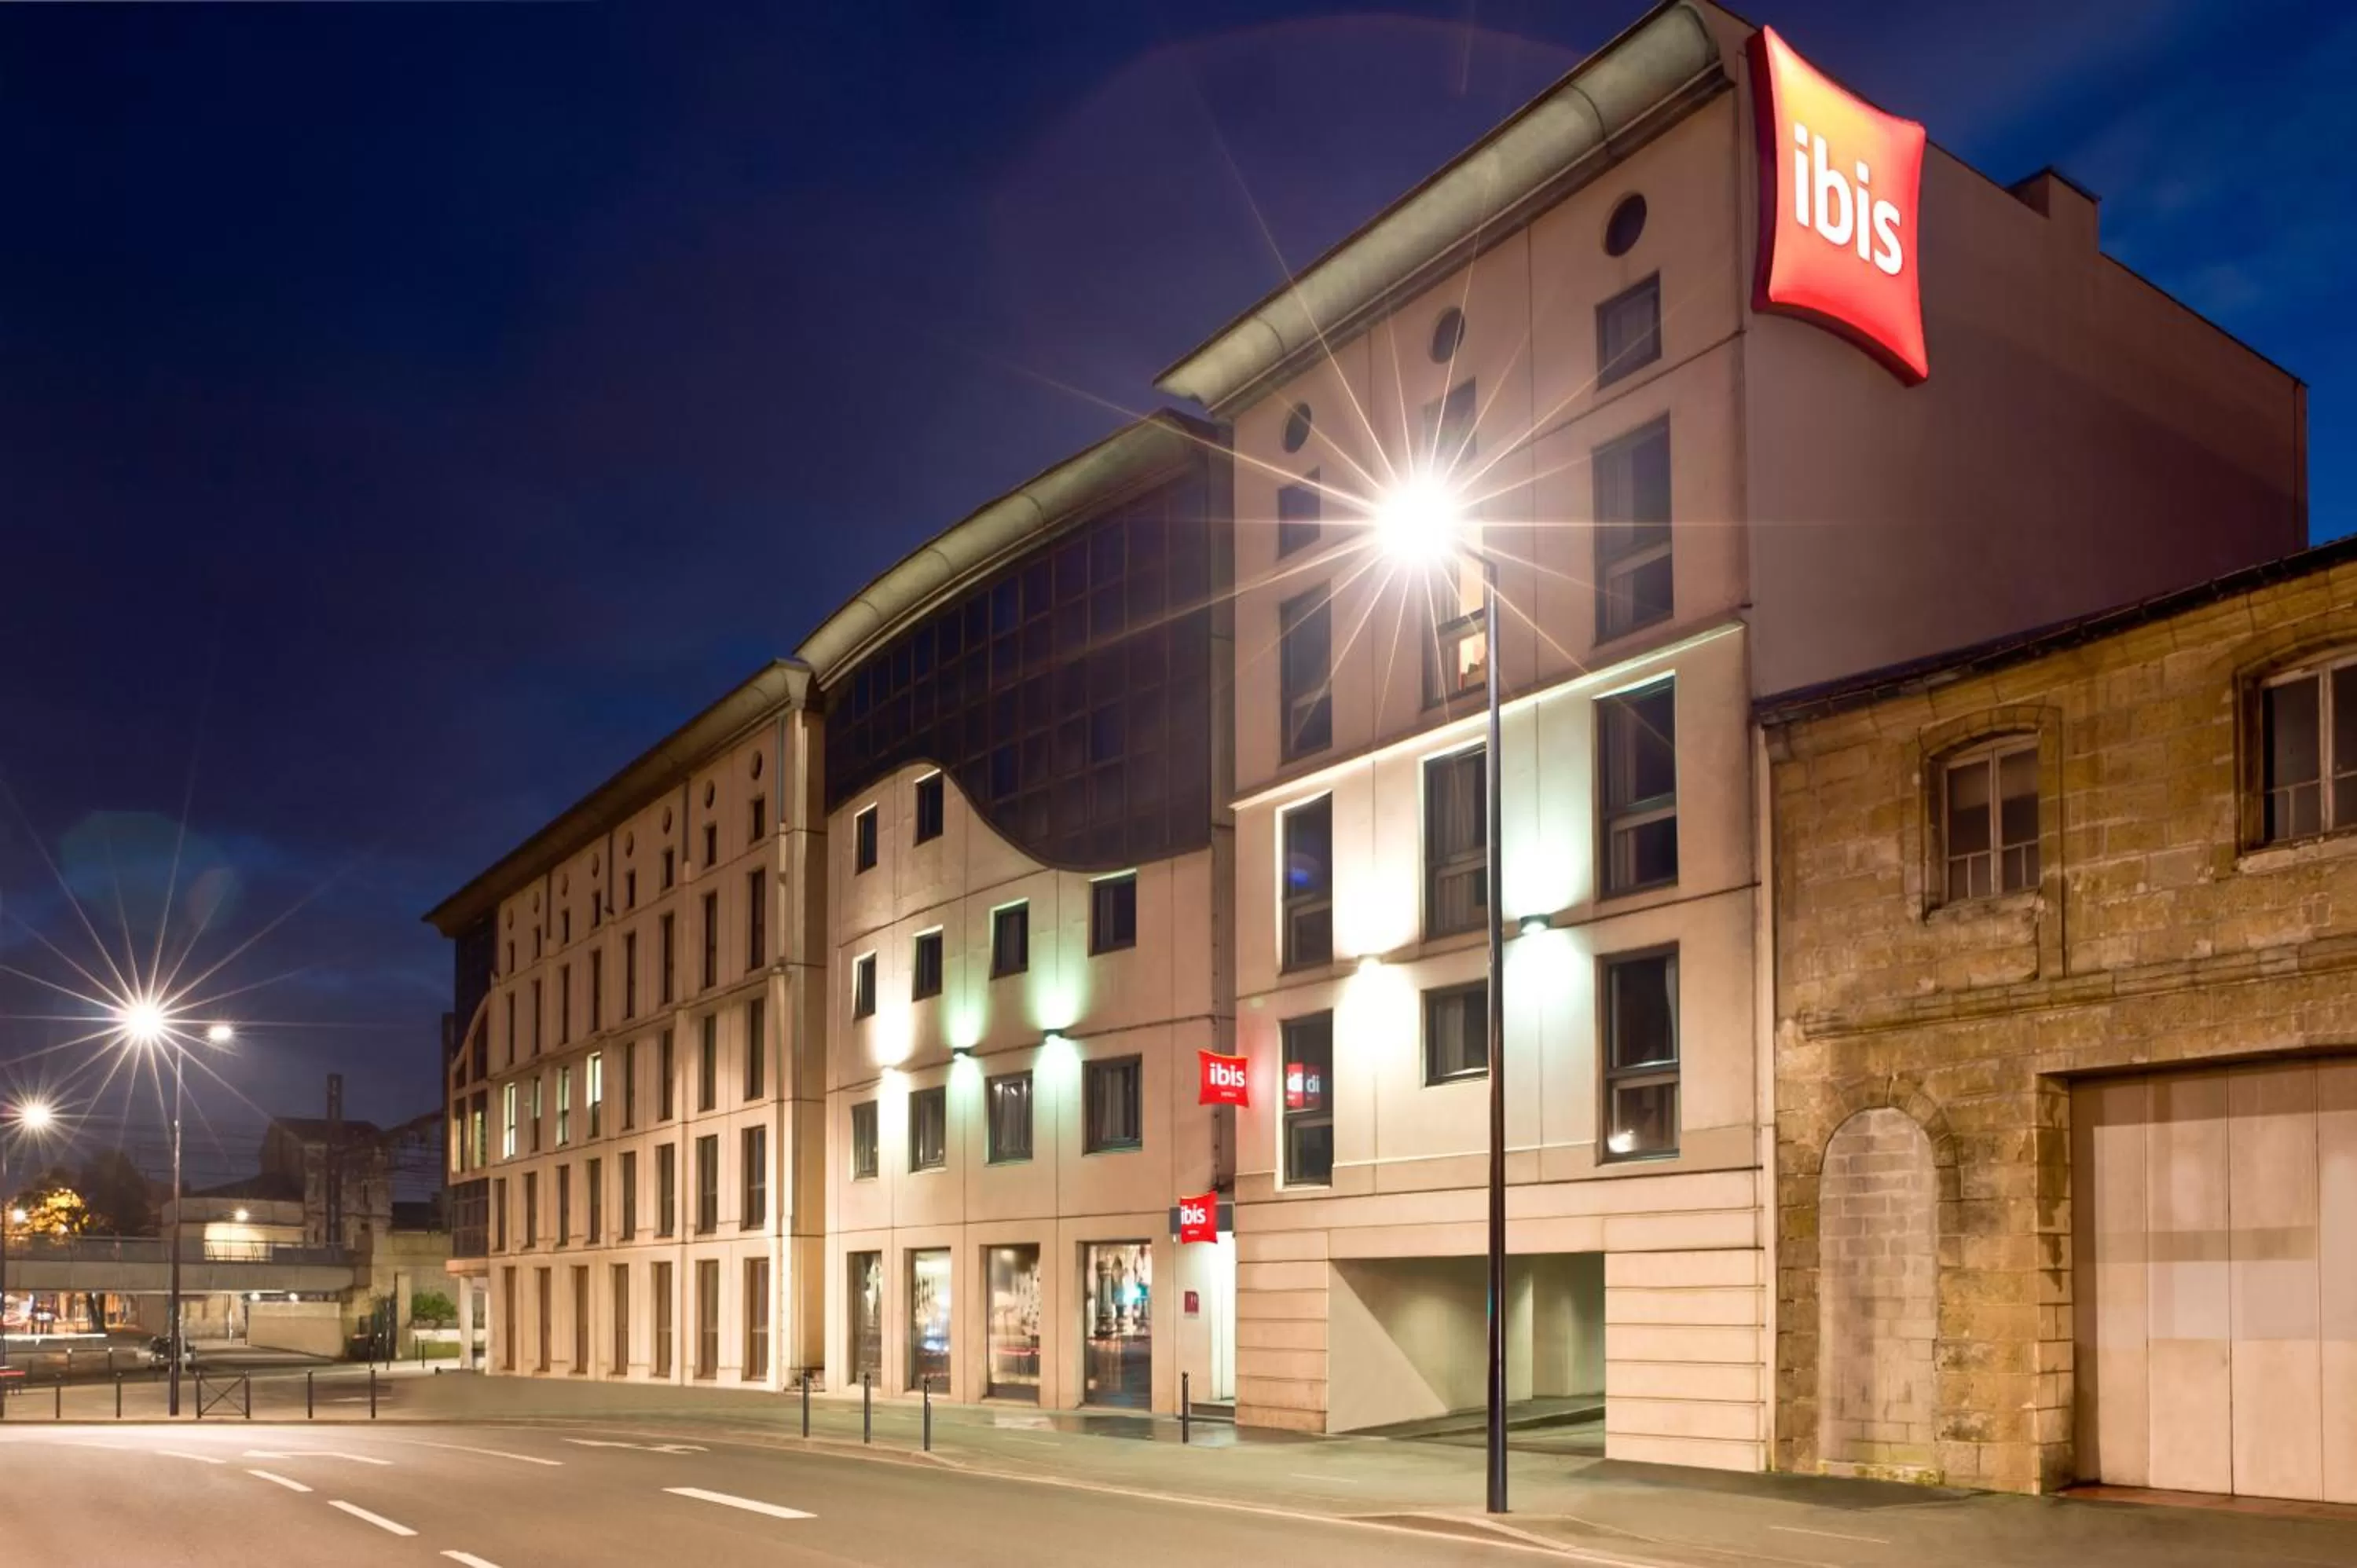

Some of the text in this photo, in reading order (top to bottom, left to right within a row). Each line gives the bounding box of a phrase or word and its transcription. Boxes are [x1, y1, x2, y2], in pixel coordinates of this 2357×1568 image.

[1794, 123, 1902, 276] ibis
[1210, 1062, 1245, 1087] ibis
[1181, 1203, 1207, 1225] ibis
